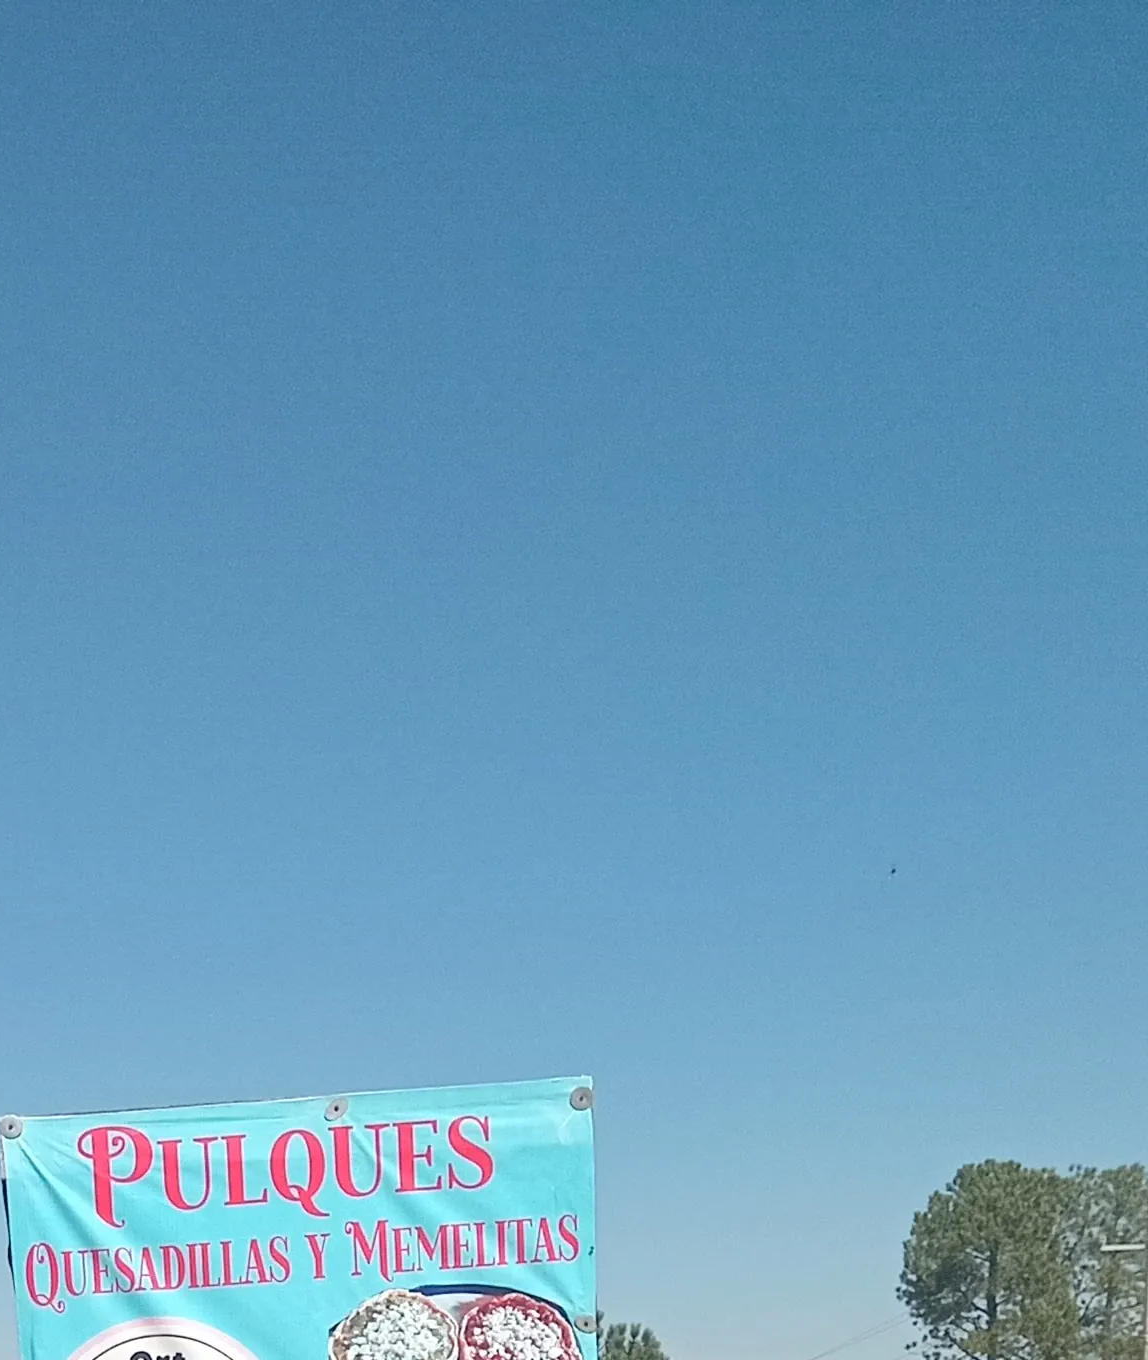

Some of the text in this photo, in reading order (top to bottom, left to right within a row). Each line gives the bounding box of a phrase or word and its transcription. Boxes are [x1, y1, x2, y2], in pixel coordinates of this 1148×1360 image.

[77, 1115, 495, 1228] PULQUES
[26, 1214, 581, 1313] QUESADILLAS Y MEMELITAS
